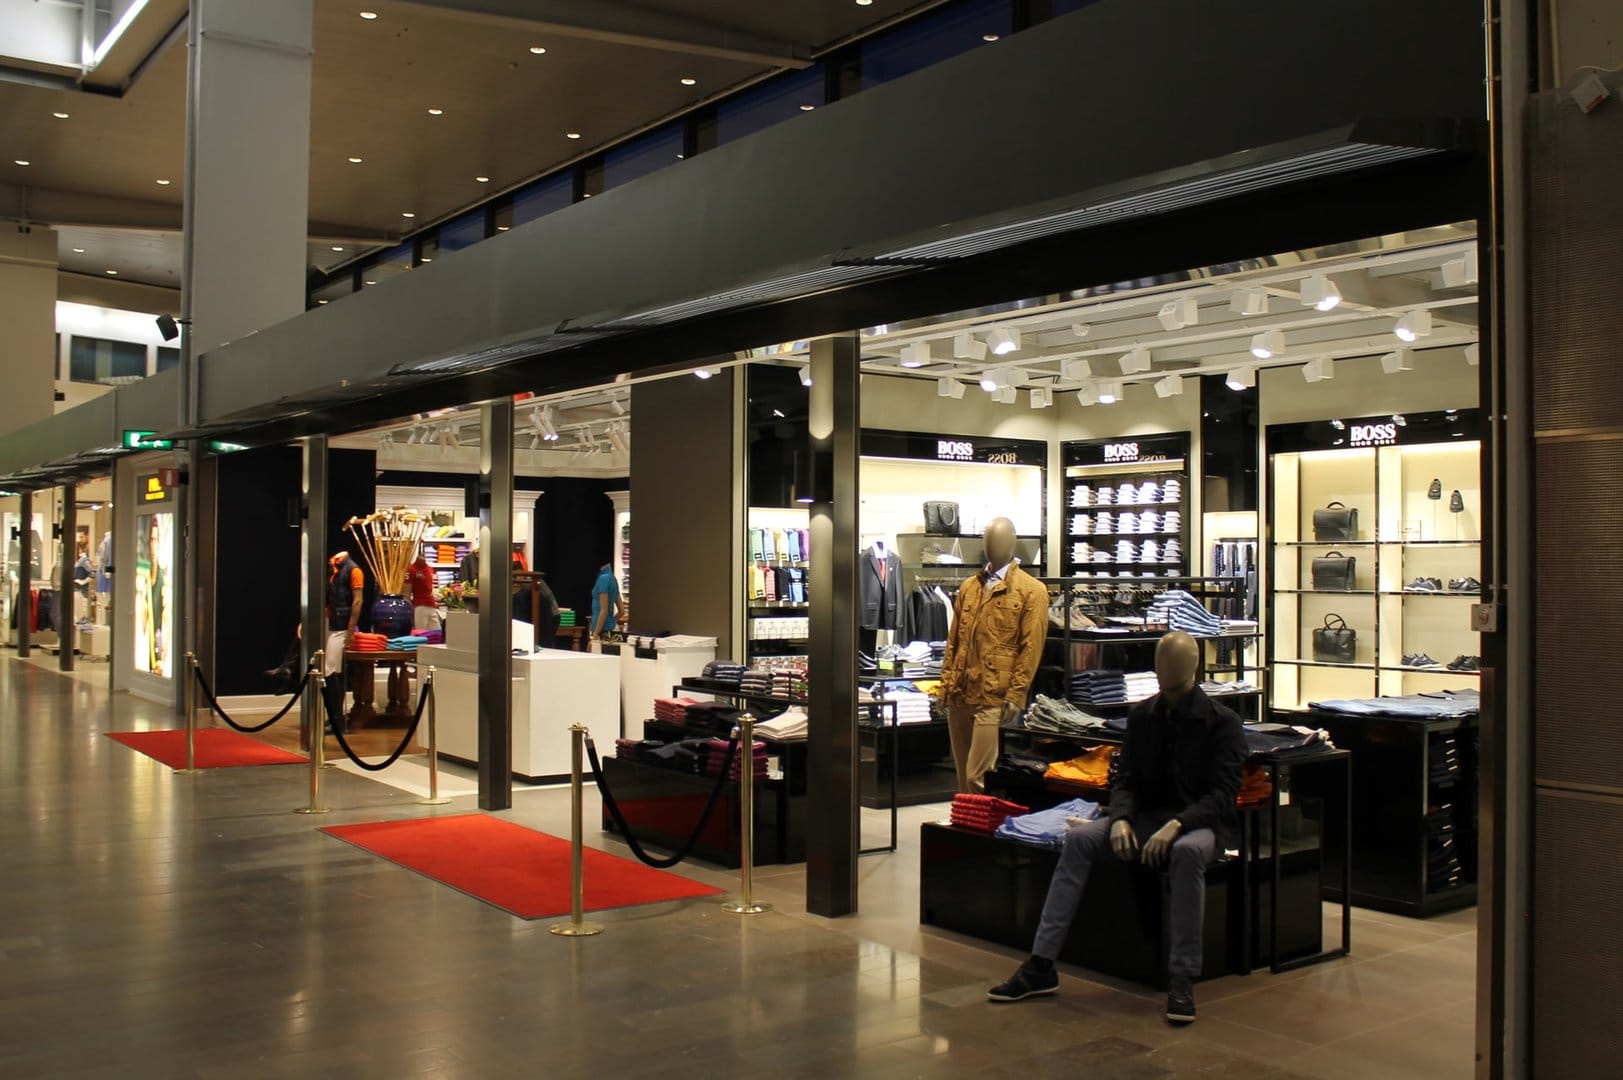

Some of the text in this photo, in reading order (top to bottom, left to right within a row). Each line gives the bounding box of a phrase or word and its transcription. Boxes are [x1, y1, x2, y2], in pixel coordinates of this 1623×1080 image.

[1350, 424, 1397, 441] BOSS
[937, 440, 974, 456] BOSS
[1103, 442, 1139, 458] BOSS
